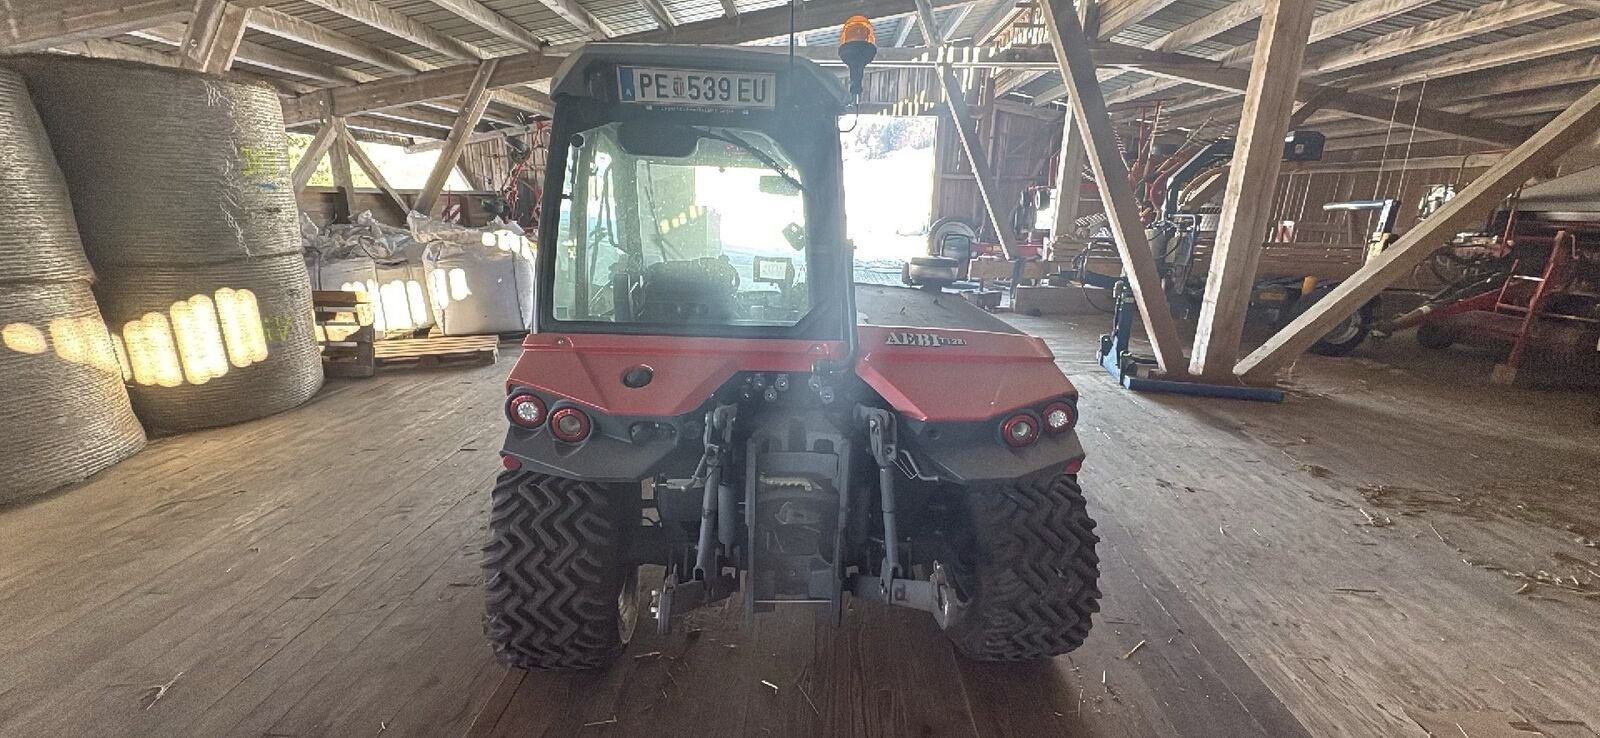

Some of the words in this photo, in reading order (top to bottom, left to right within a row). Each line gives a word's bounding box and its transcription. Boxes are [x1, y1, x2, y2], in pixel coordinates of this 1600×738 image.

[639, 73, 669, 98] PE
[687, 75, 731, 101] 539
[738, 77, 766, 103] EU
[885, 331, 941, 346] AEBI
